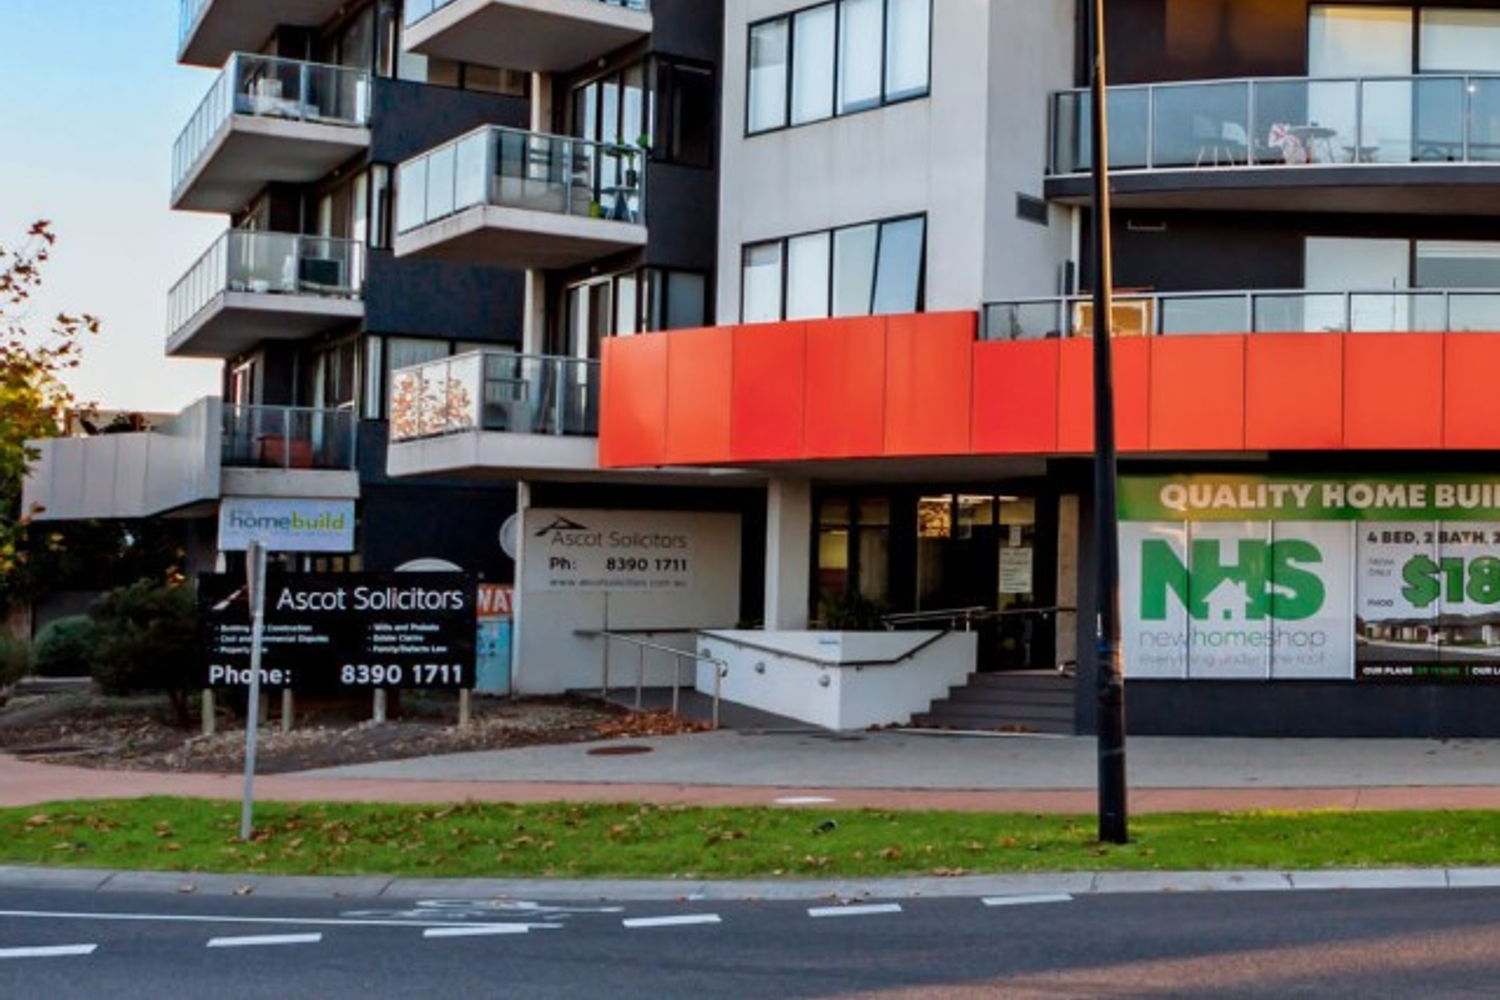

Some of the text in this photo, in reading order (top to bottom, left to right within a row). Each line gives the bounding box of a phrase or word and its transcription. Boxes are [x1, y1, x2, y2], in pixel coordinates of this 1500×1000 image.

[1160, 483, 1313, 511] QUALITY
[1322, 484, 1426, 509] HOME
[229, 510, 345, 530] homebuild
[552, 531, 688, 548] Ascot Solicitors
[1367, 532, 1377, 544] 4
[1381, 532, 1419, 546] BED,
[1424, 532, 1434, 544] 2
[549, 557, 687, 571] Ph: 8390 1711
[1140, 538, 1326, 621] NHS
[277, 586, 463, 610] Ascot Solicitors
[1139, 629, 1326, 651] newhomeshop
[209, 664, 462, 684] Phone: 8390 1711
